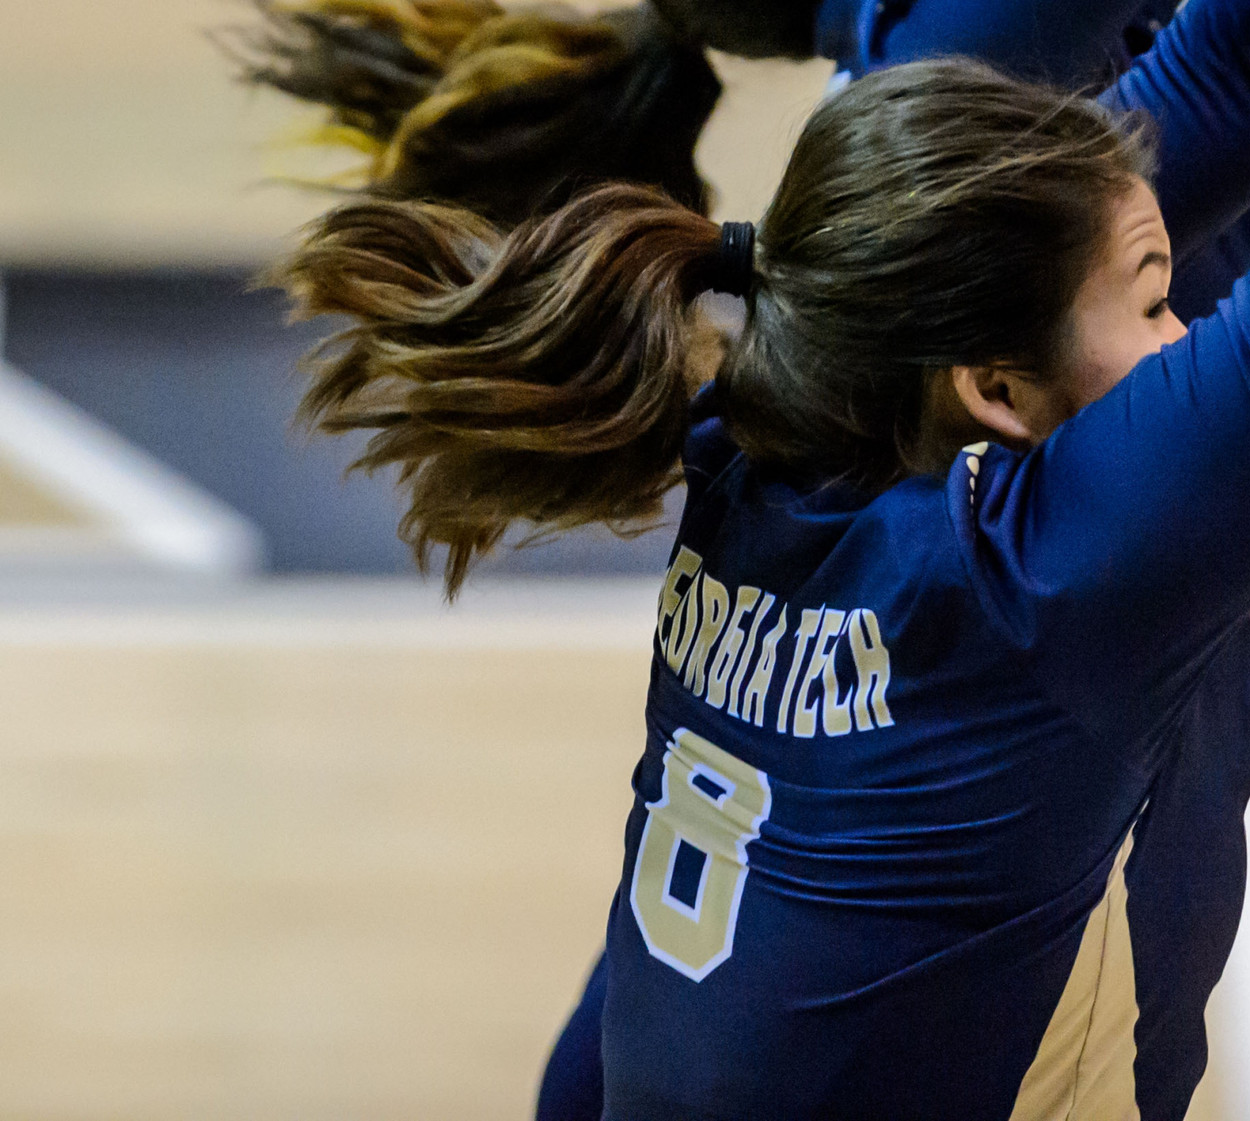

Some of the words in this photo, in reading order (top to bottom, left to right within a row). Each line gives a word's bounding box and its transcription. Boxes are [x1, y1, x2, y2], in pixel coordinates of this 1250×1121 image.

[658, 545, 787, 728] EORGIA
[777, 603, 895, 739] TECH
[630, 727, 772, 983] 8
